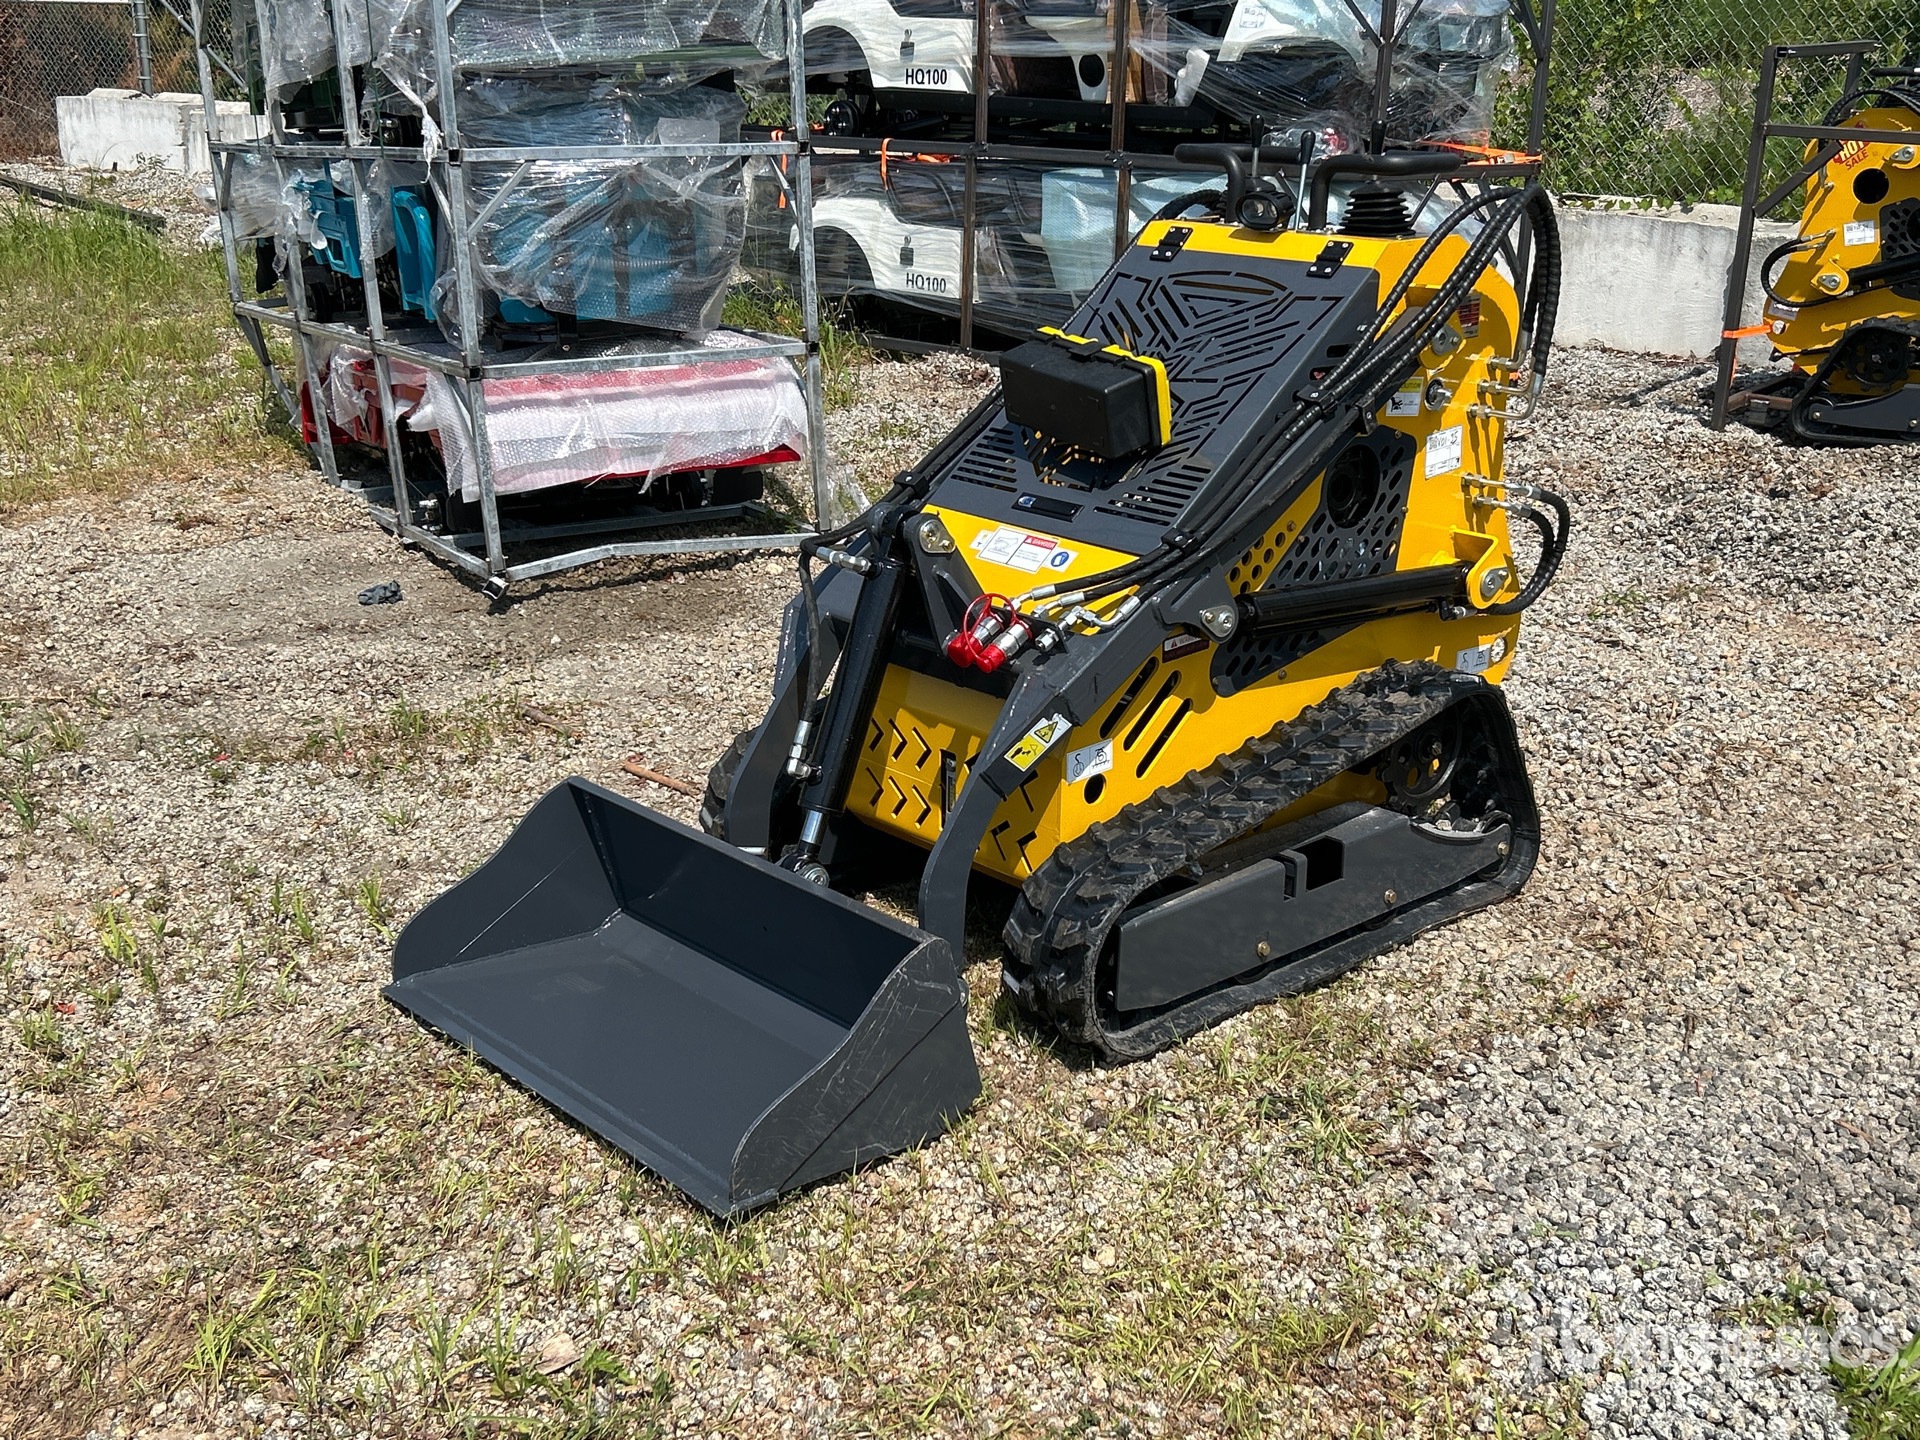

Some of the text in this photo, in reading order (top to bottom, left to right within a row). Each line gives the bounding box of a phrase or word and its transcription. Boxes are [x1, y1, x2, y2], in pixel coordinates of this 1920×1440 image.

[905, 68, 948, 85] HQ100
[1845, 149, 1869, 171] SALE
[906, 272, 947, 294] HQ100
[1033, 538, 1056, 549] DANGER
